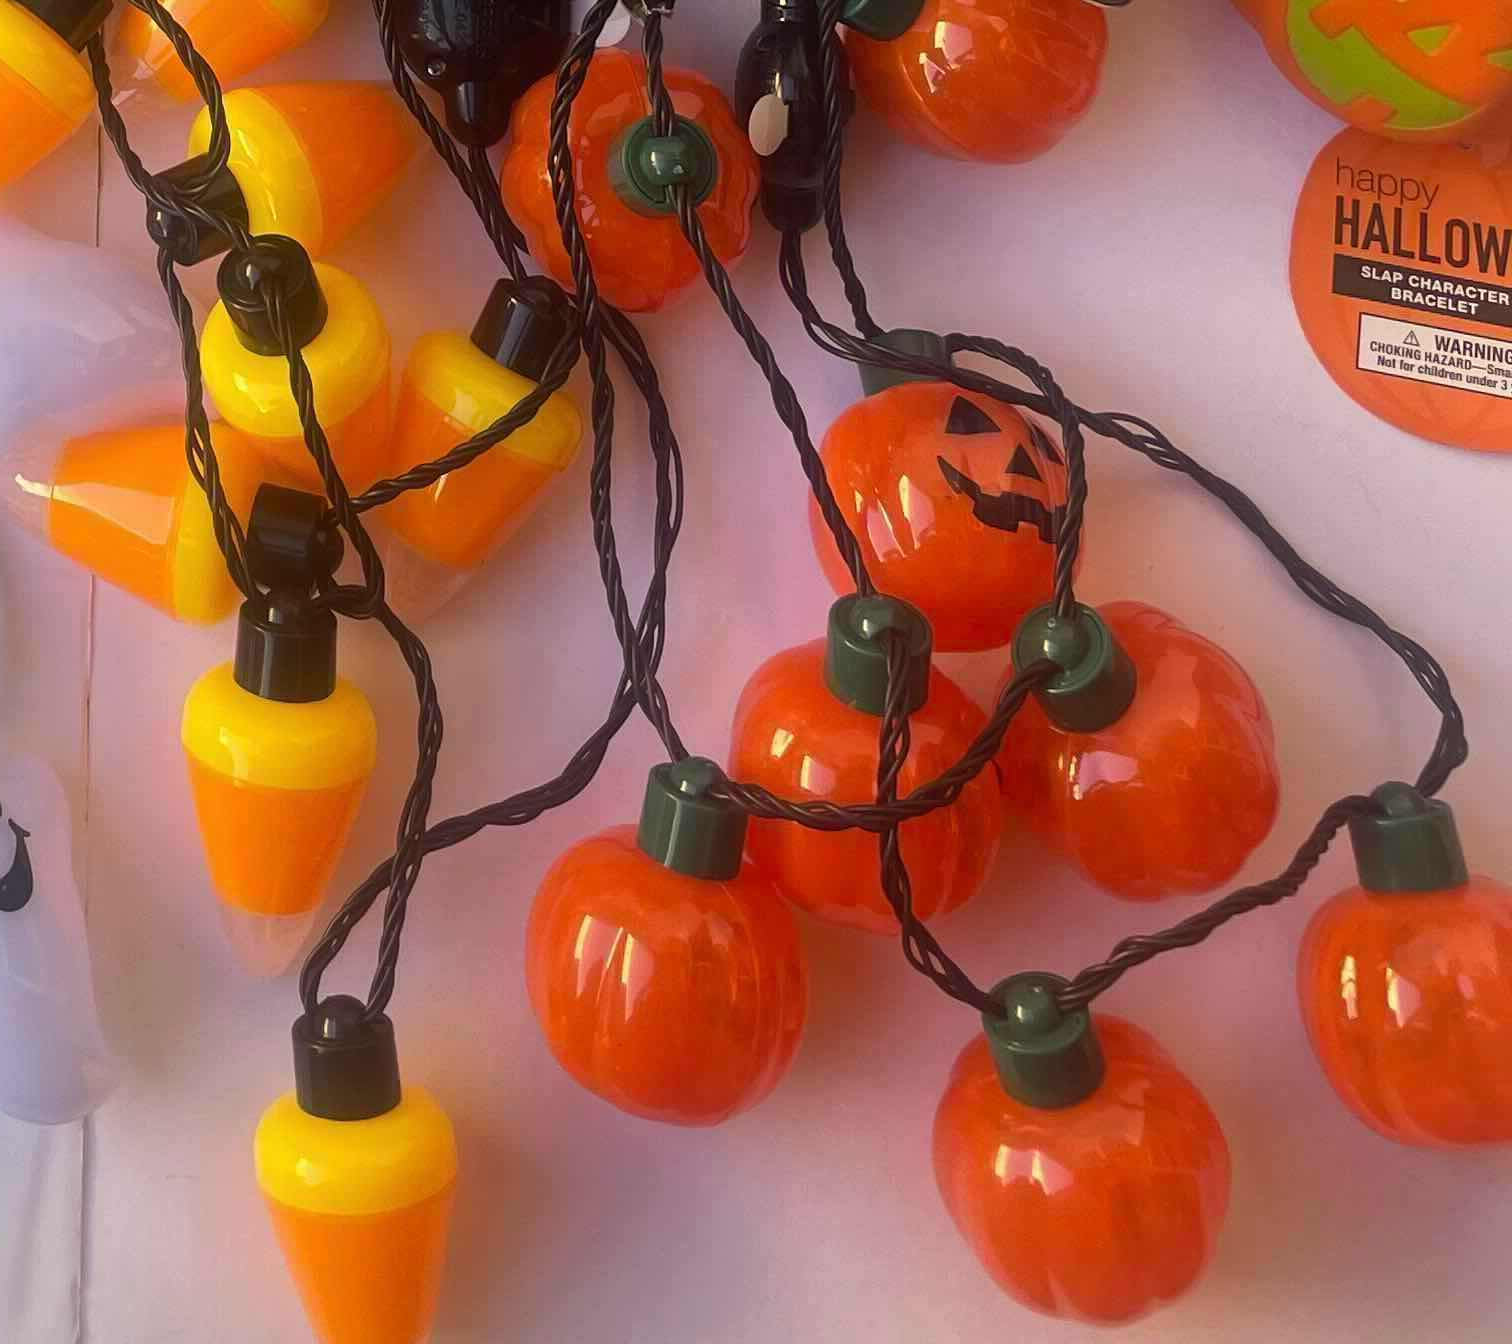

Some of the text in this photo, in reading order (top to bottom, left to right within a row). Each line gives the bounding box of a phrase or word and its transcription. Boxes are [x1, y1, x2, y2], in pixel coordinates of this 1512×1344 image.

[1336, 156, 1440, 211] happy
[1360, 265, 1510, 306] SLAP CHARACTER
[1391, 287, 1479, 315] BRACELET
[1369, 340, 1422, 361] CHOKING
[1376, 354, 1463, 382] Not for children
